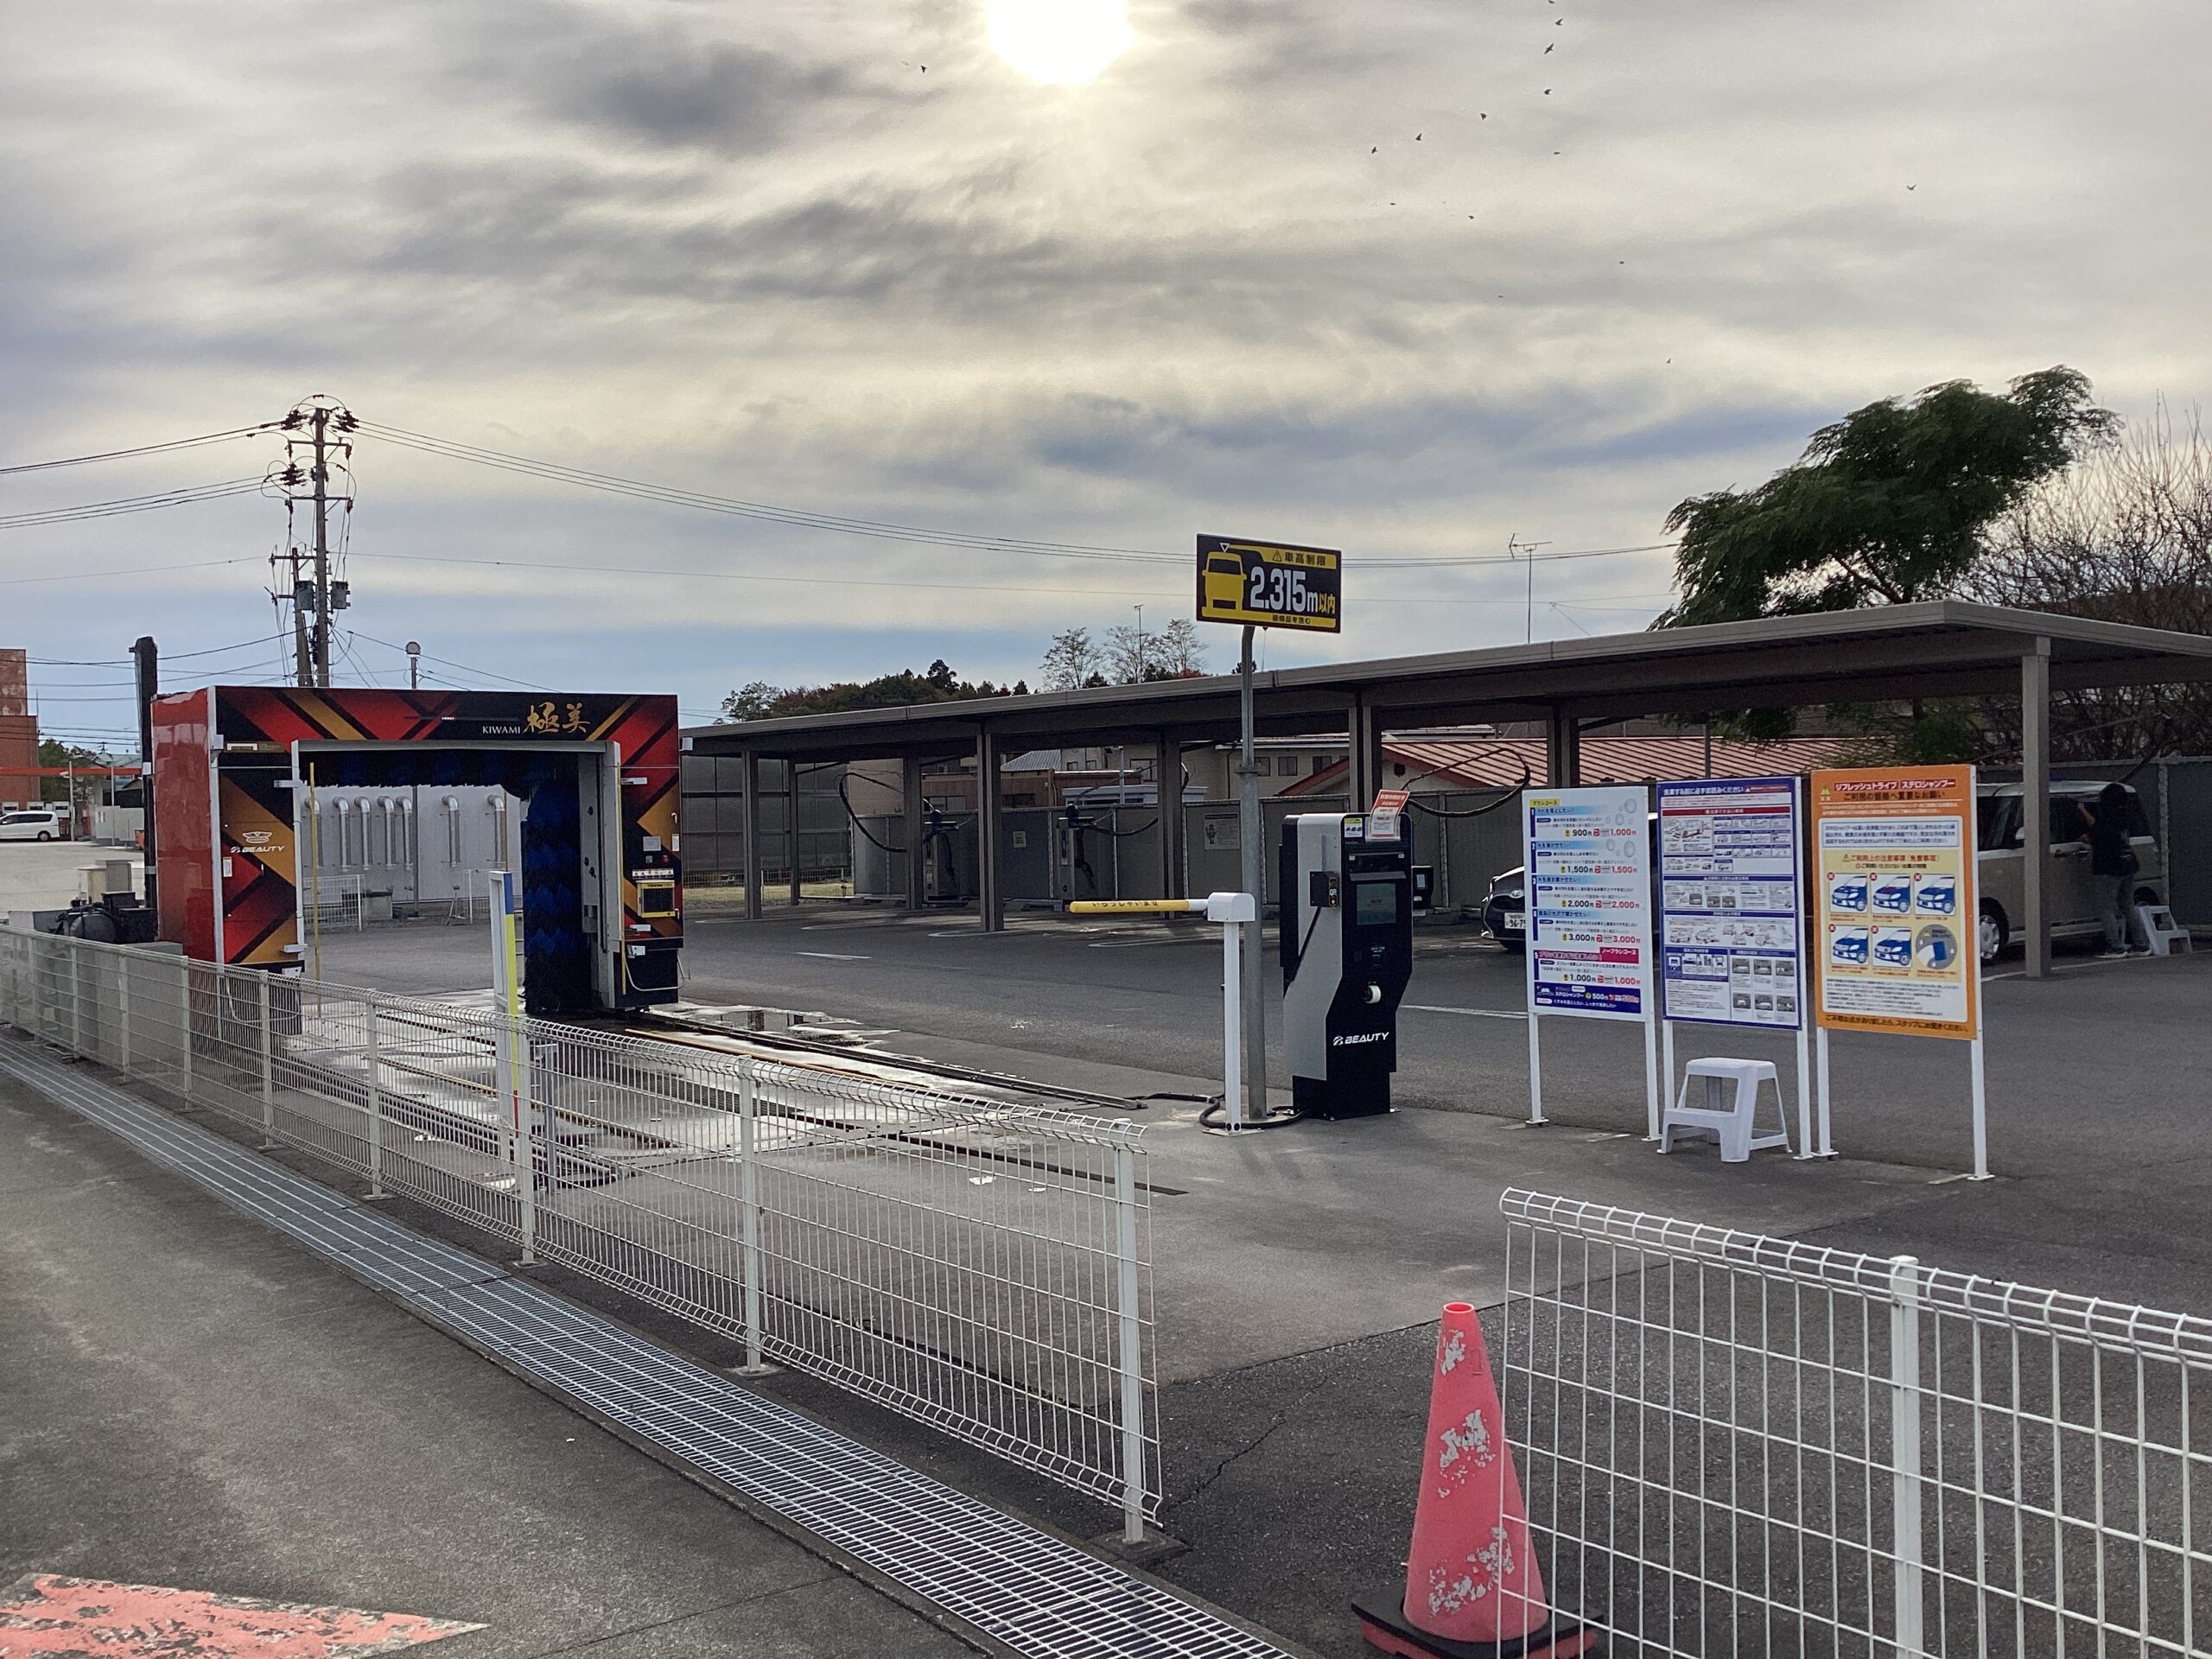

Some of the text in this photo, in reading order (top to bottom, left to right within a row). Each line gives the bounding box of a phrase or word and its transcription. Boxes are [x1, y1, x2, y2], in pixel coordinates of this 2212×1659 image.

[1285, 551, 1325, 567] 車高制限
[523, 702, 591, 734] 極美
[1570, 974, 1596, 982] 1,000円
[1344, 1032, 1389, 1045] BEAUTY
